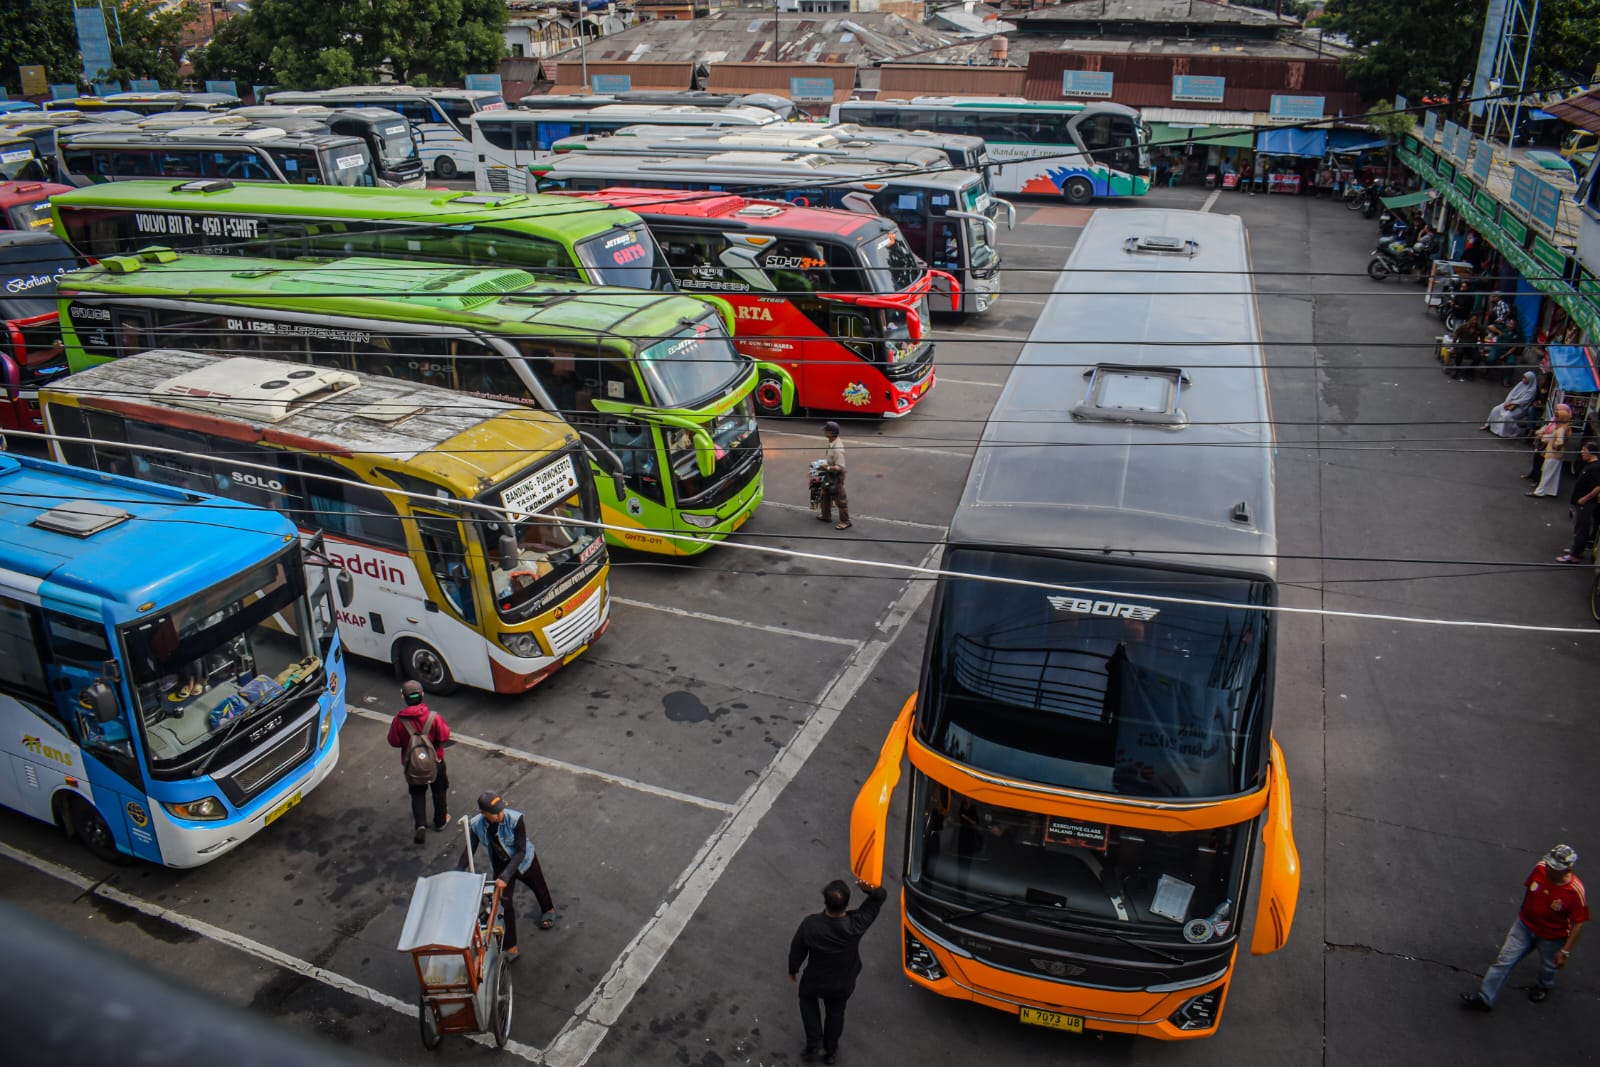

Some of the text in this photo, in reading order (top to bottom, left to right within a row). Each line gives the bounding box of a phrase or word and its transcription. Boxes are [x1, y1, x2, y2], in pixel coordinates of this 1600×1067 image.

[992, 147, 1028, 158] Bandung
[136, 214, 167, 233] VOLVO
[184, 216, 194, 235] R
[202, 217, 221, 236] 450
[223, 218, 259, 238] I-SHIFT
[682, 279, 750, 292] SUSPENSION
[735, 305, 774, 321] RTA
[227, 318, 243, 331] OH
[277, 324, 370, 343] SUSPENSION
[231, 471, 283, 491] SOLO
[505, 481, 535, 504] BANDUNG
[536, 459, 571, 486] PURWOKERTO
[517, 492, 538, 508] TASIK
[542, 474, 568, 493] BANJAR
[525, 485, 565, 513] EKONOMI AC
[329, 552, 406, 586] addin
[335, 609, 367, 629] AKAP
[249, 715, 283, 742] ISUZU
[1049, 827, 1073, 835] MALANG
[1076, 831, 1104, 840] BANDUNG
[1052, 822, 1101, 835] EXECUTIVE CLASS
[1023, 1009, 1030, 1018] N
[1036, 1012, 1061, 1024] 7073
